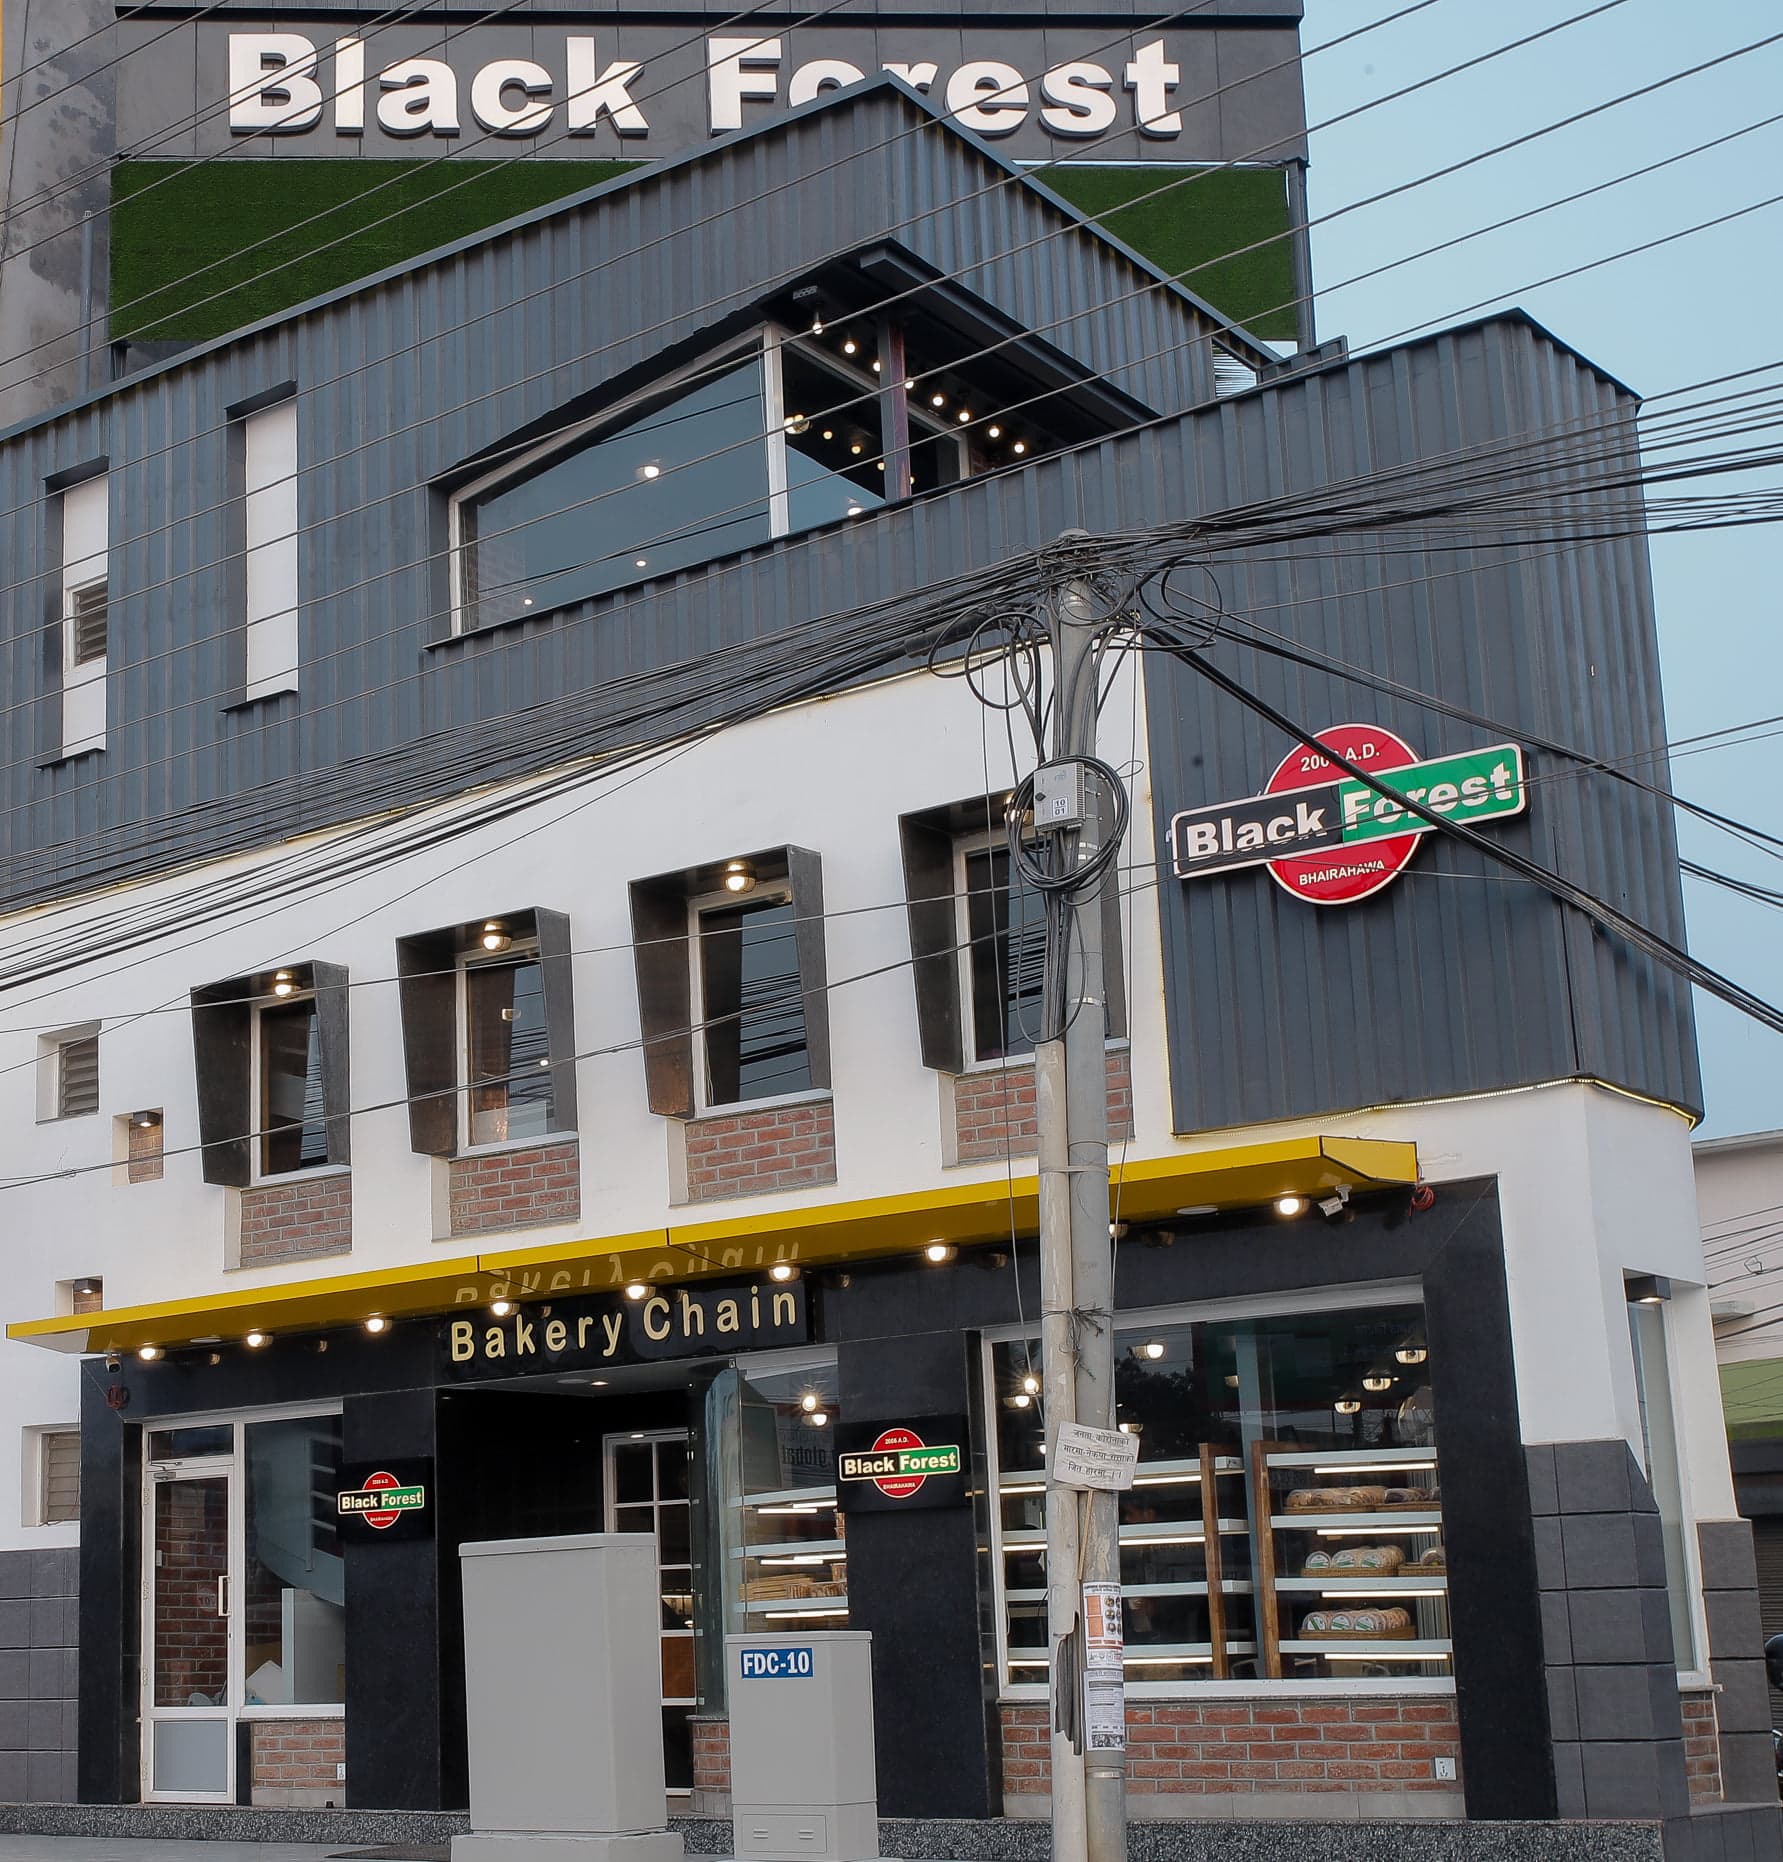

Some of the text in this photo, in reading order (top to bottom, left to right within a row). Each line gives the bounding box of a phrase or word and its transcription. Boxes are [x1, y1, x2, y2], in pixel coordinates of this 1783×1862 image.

[228, 33, 649, 138] Black
[1301, 743, 1380, 772] 200 A.D.
[1054, 799, 1066, 807] 10
[1186, 802, 1328, 862] Black
[1298, 858, 1385, 886] BHAIRAHAWA
[451, 1285, 796, 1362] Bakery Chain
[844, 1456, 896, 1475] Black
[900, 1451, 957, 1471] Forest
[341, 1491, 422, 1510] Black Forest
[743, 1651, 810, 1675] FDC-10
